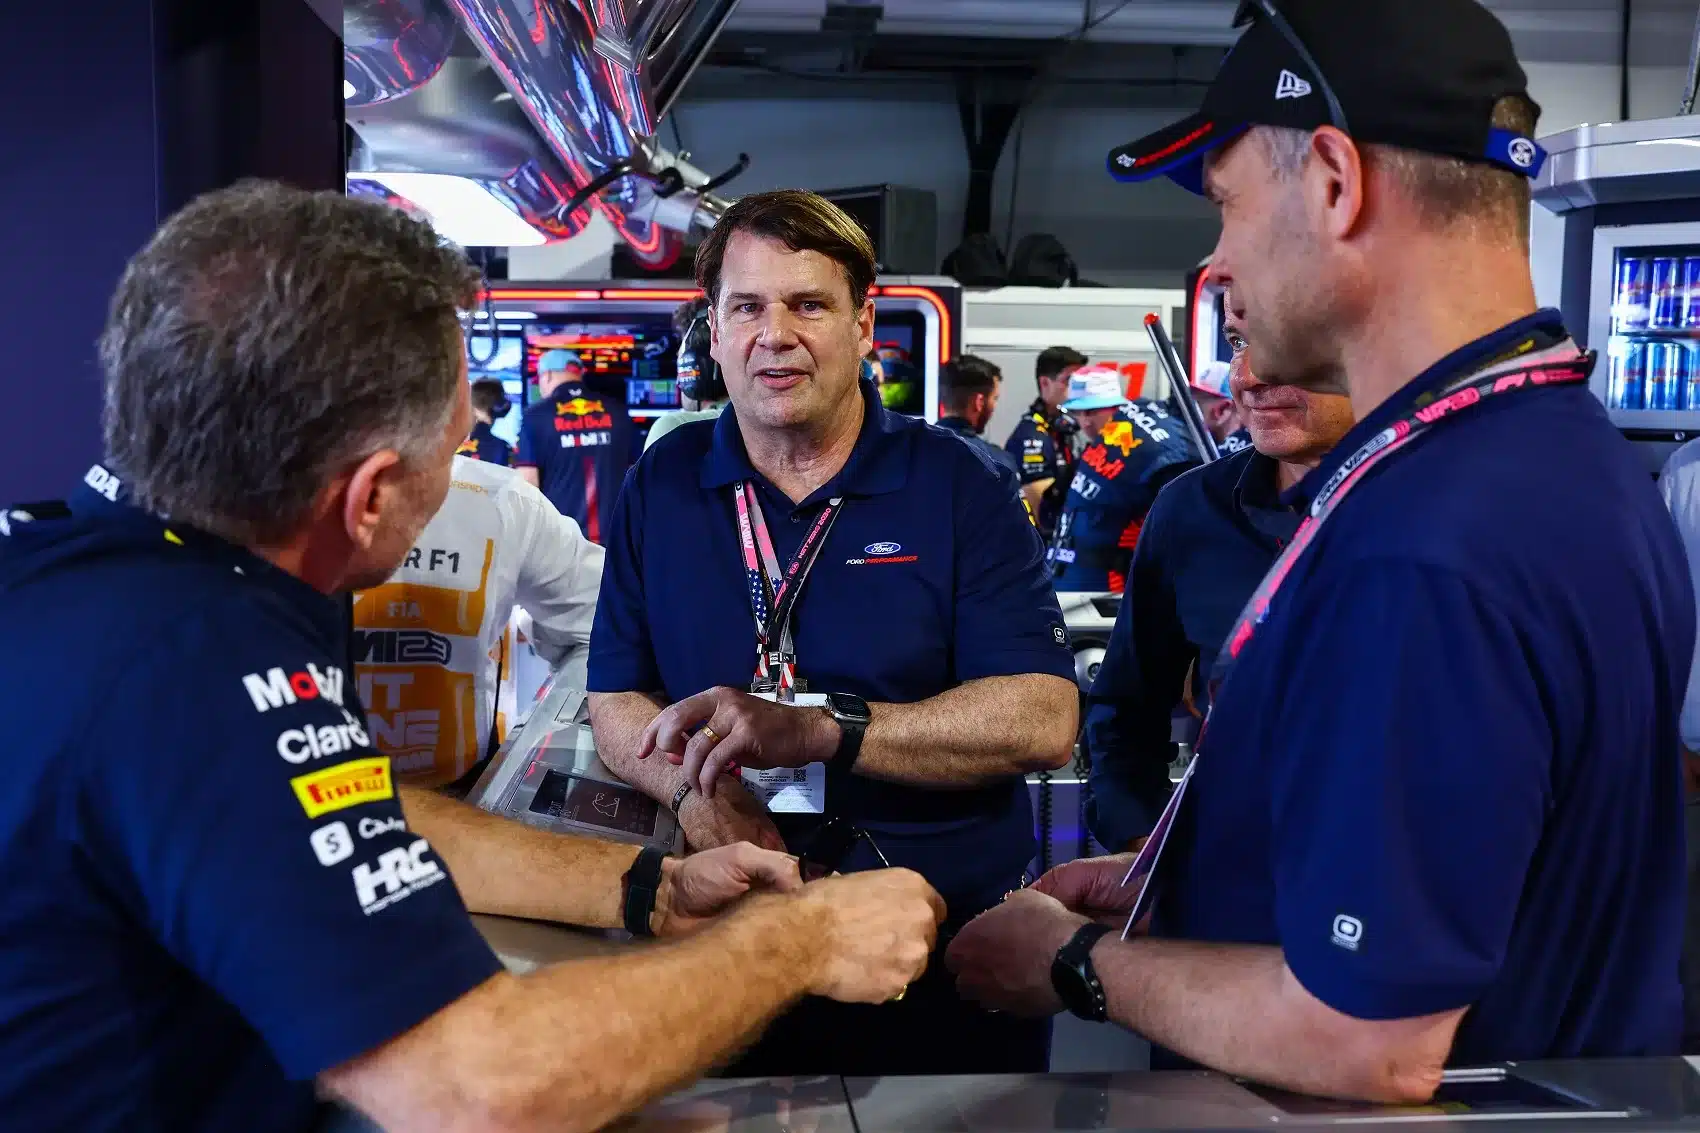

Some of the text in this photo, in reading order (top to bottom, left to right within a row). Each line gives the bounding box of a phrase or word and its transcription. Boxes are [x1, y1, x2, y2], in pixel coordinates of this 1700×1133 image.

[553, 413, 613, 432] Red Bull
[429, 548, 460, 573] F1
[865, 555, 918, 564] PERFORMANCE
[387, 602, 420, 617] FIA
[242, 662, 344, 713] Mobil
[359, 673, 414, 710] IT
[276, 723, 370, 764] Claro
[352, 838, 439, 908] HRC
